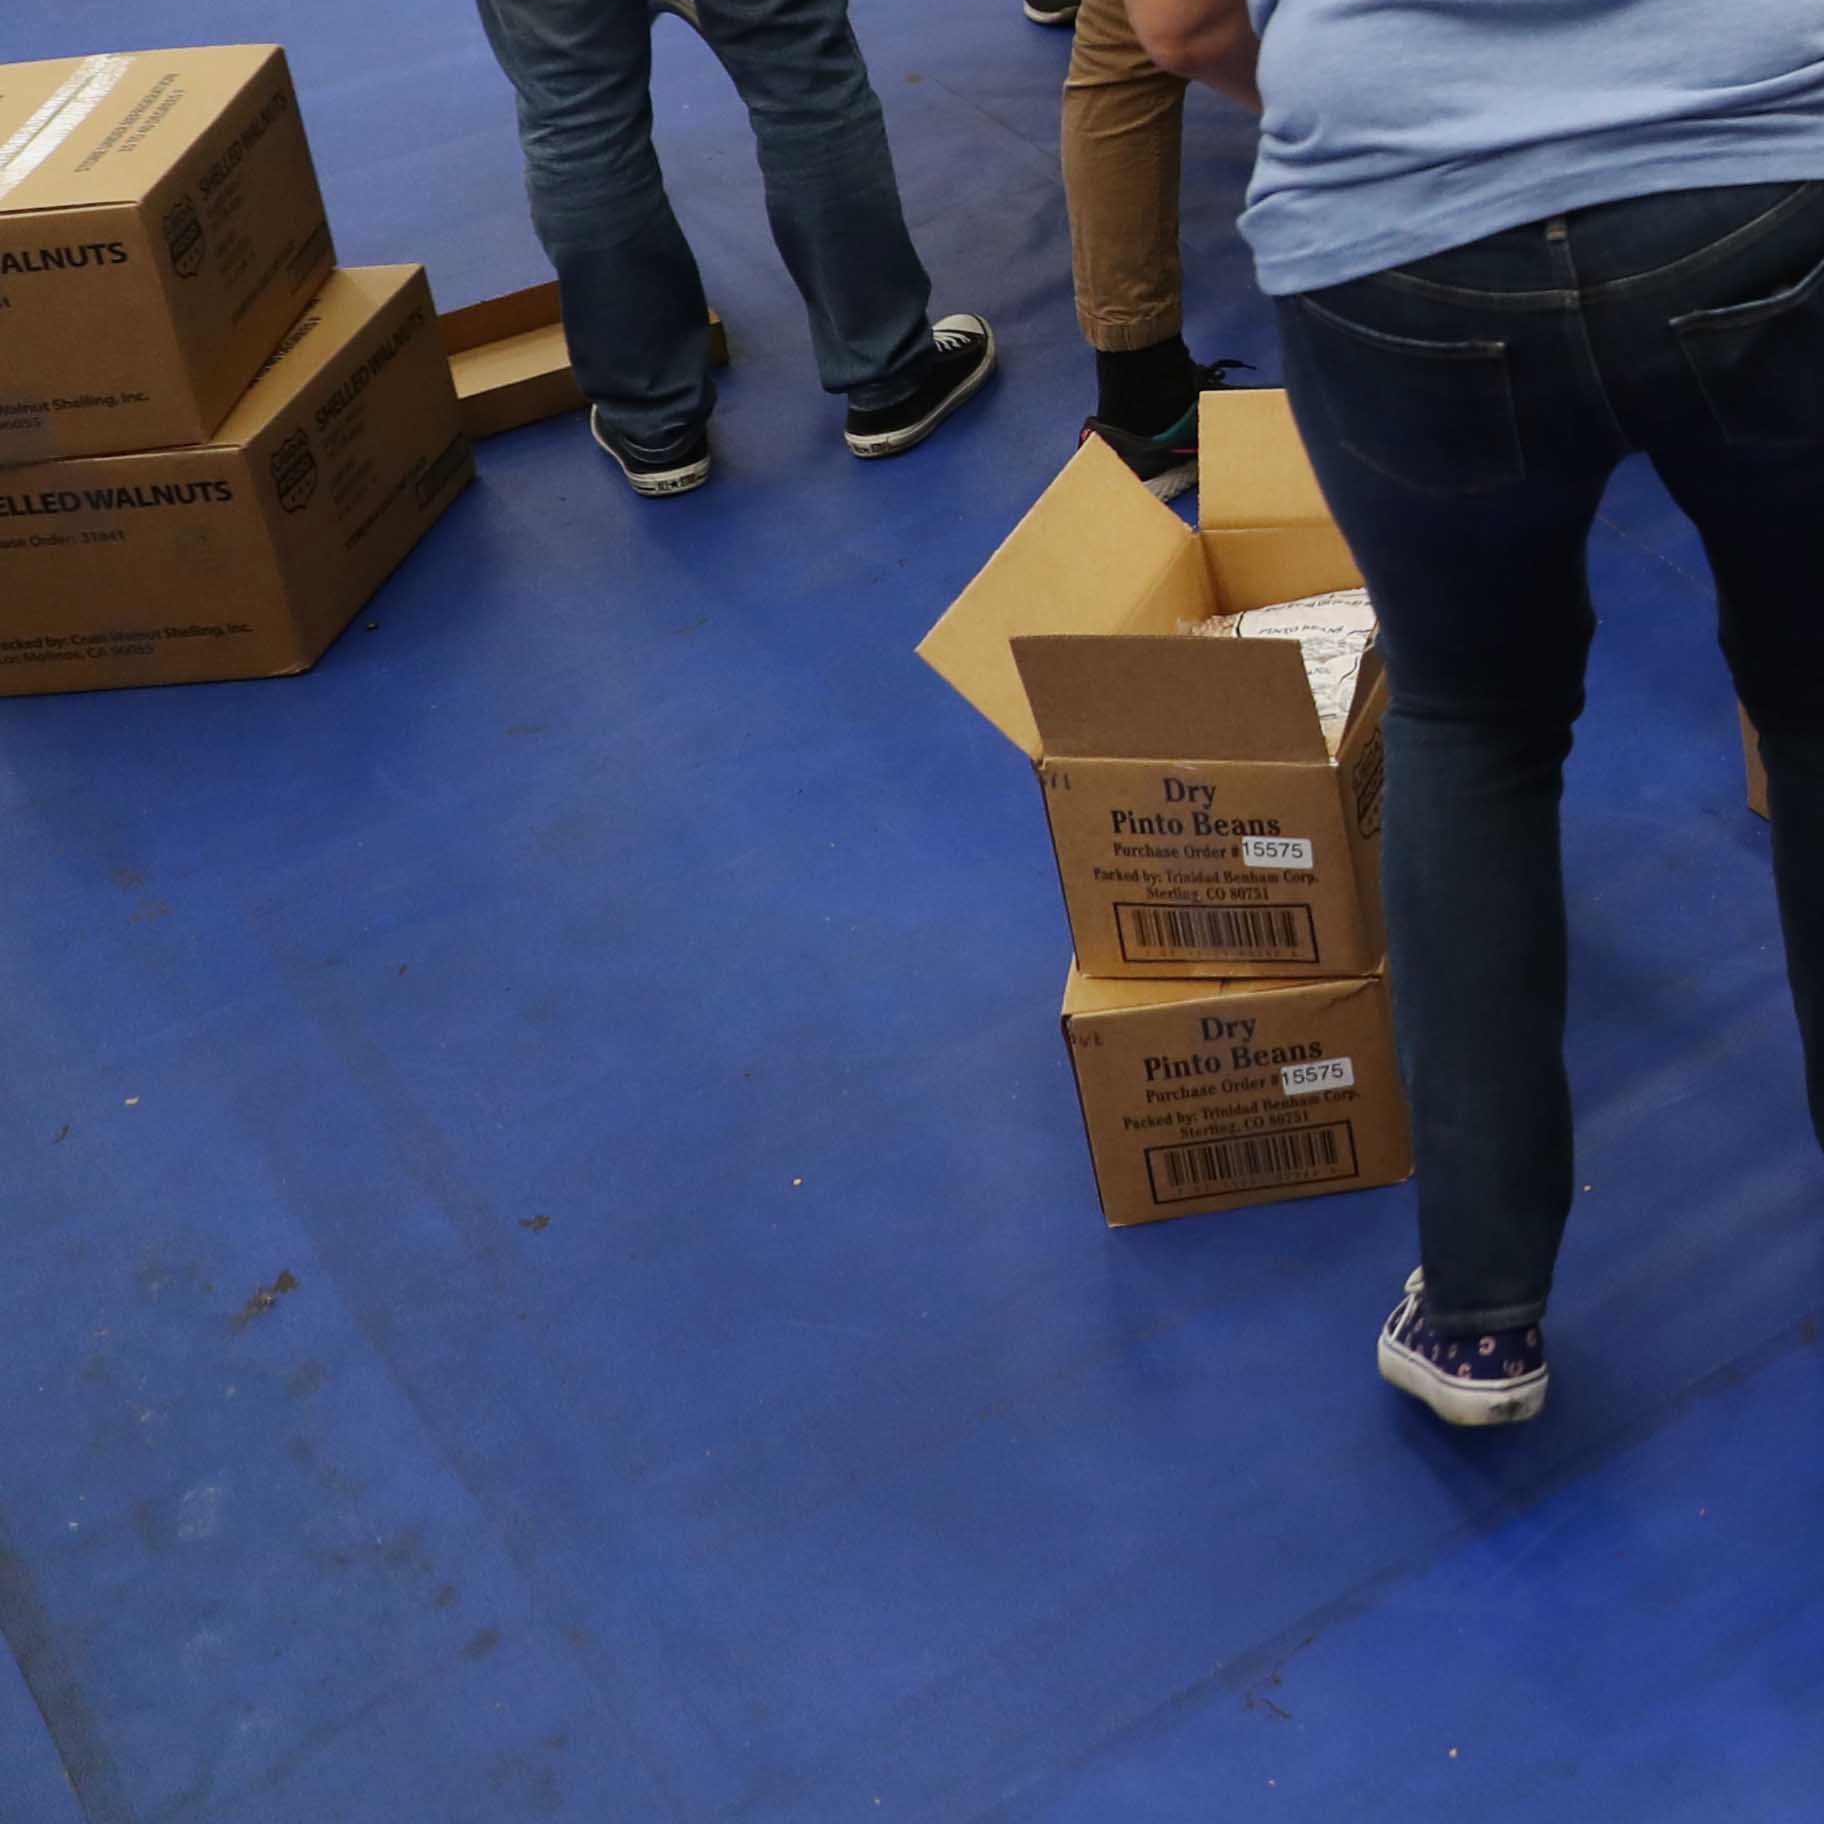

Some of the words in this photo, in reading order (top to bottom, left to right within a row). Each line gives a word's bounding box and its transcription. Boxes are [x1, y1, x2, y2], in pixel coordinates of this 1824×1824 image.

[54, 392, 120, 412] Shelling,
[83, 480, 233, 511] WALNUTS
[1163, 777, 1216, 809] Dry
[1110, 810, 1183, 835] Pinto
[1193, 812, 1281, 837] Beans
[1113, 842, 1180, 859] Purchase
[1184, 845, 1227, 859] Order
[1094, 867, 1139, 882] Packed
[1143, 868, 1160, 883] by:
[1283, 869, 1319, 885] Corp.
[1206, 887, 1225, 900] CO
[1201, 1016, 1257, 1042] Dry
[1143, 1056, 1221, 1081] Pinto
[1231, 1040, 1323, 1070] Beans
[1145, 1085, 1217, 1103] Purchase
[1221, 1077, 1267, 1094] Order
[1122, 1114, 1174, 1131] Packed
[1176, 1112, 1198, 1127] by:
[1202, 1103, 1259, 1121] Trinidad
[1323, 1088, 1361, 1104] Corp.
[1244, 1118, 1265, 1131] CO
